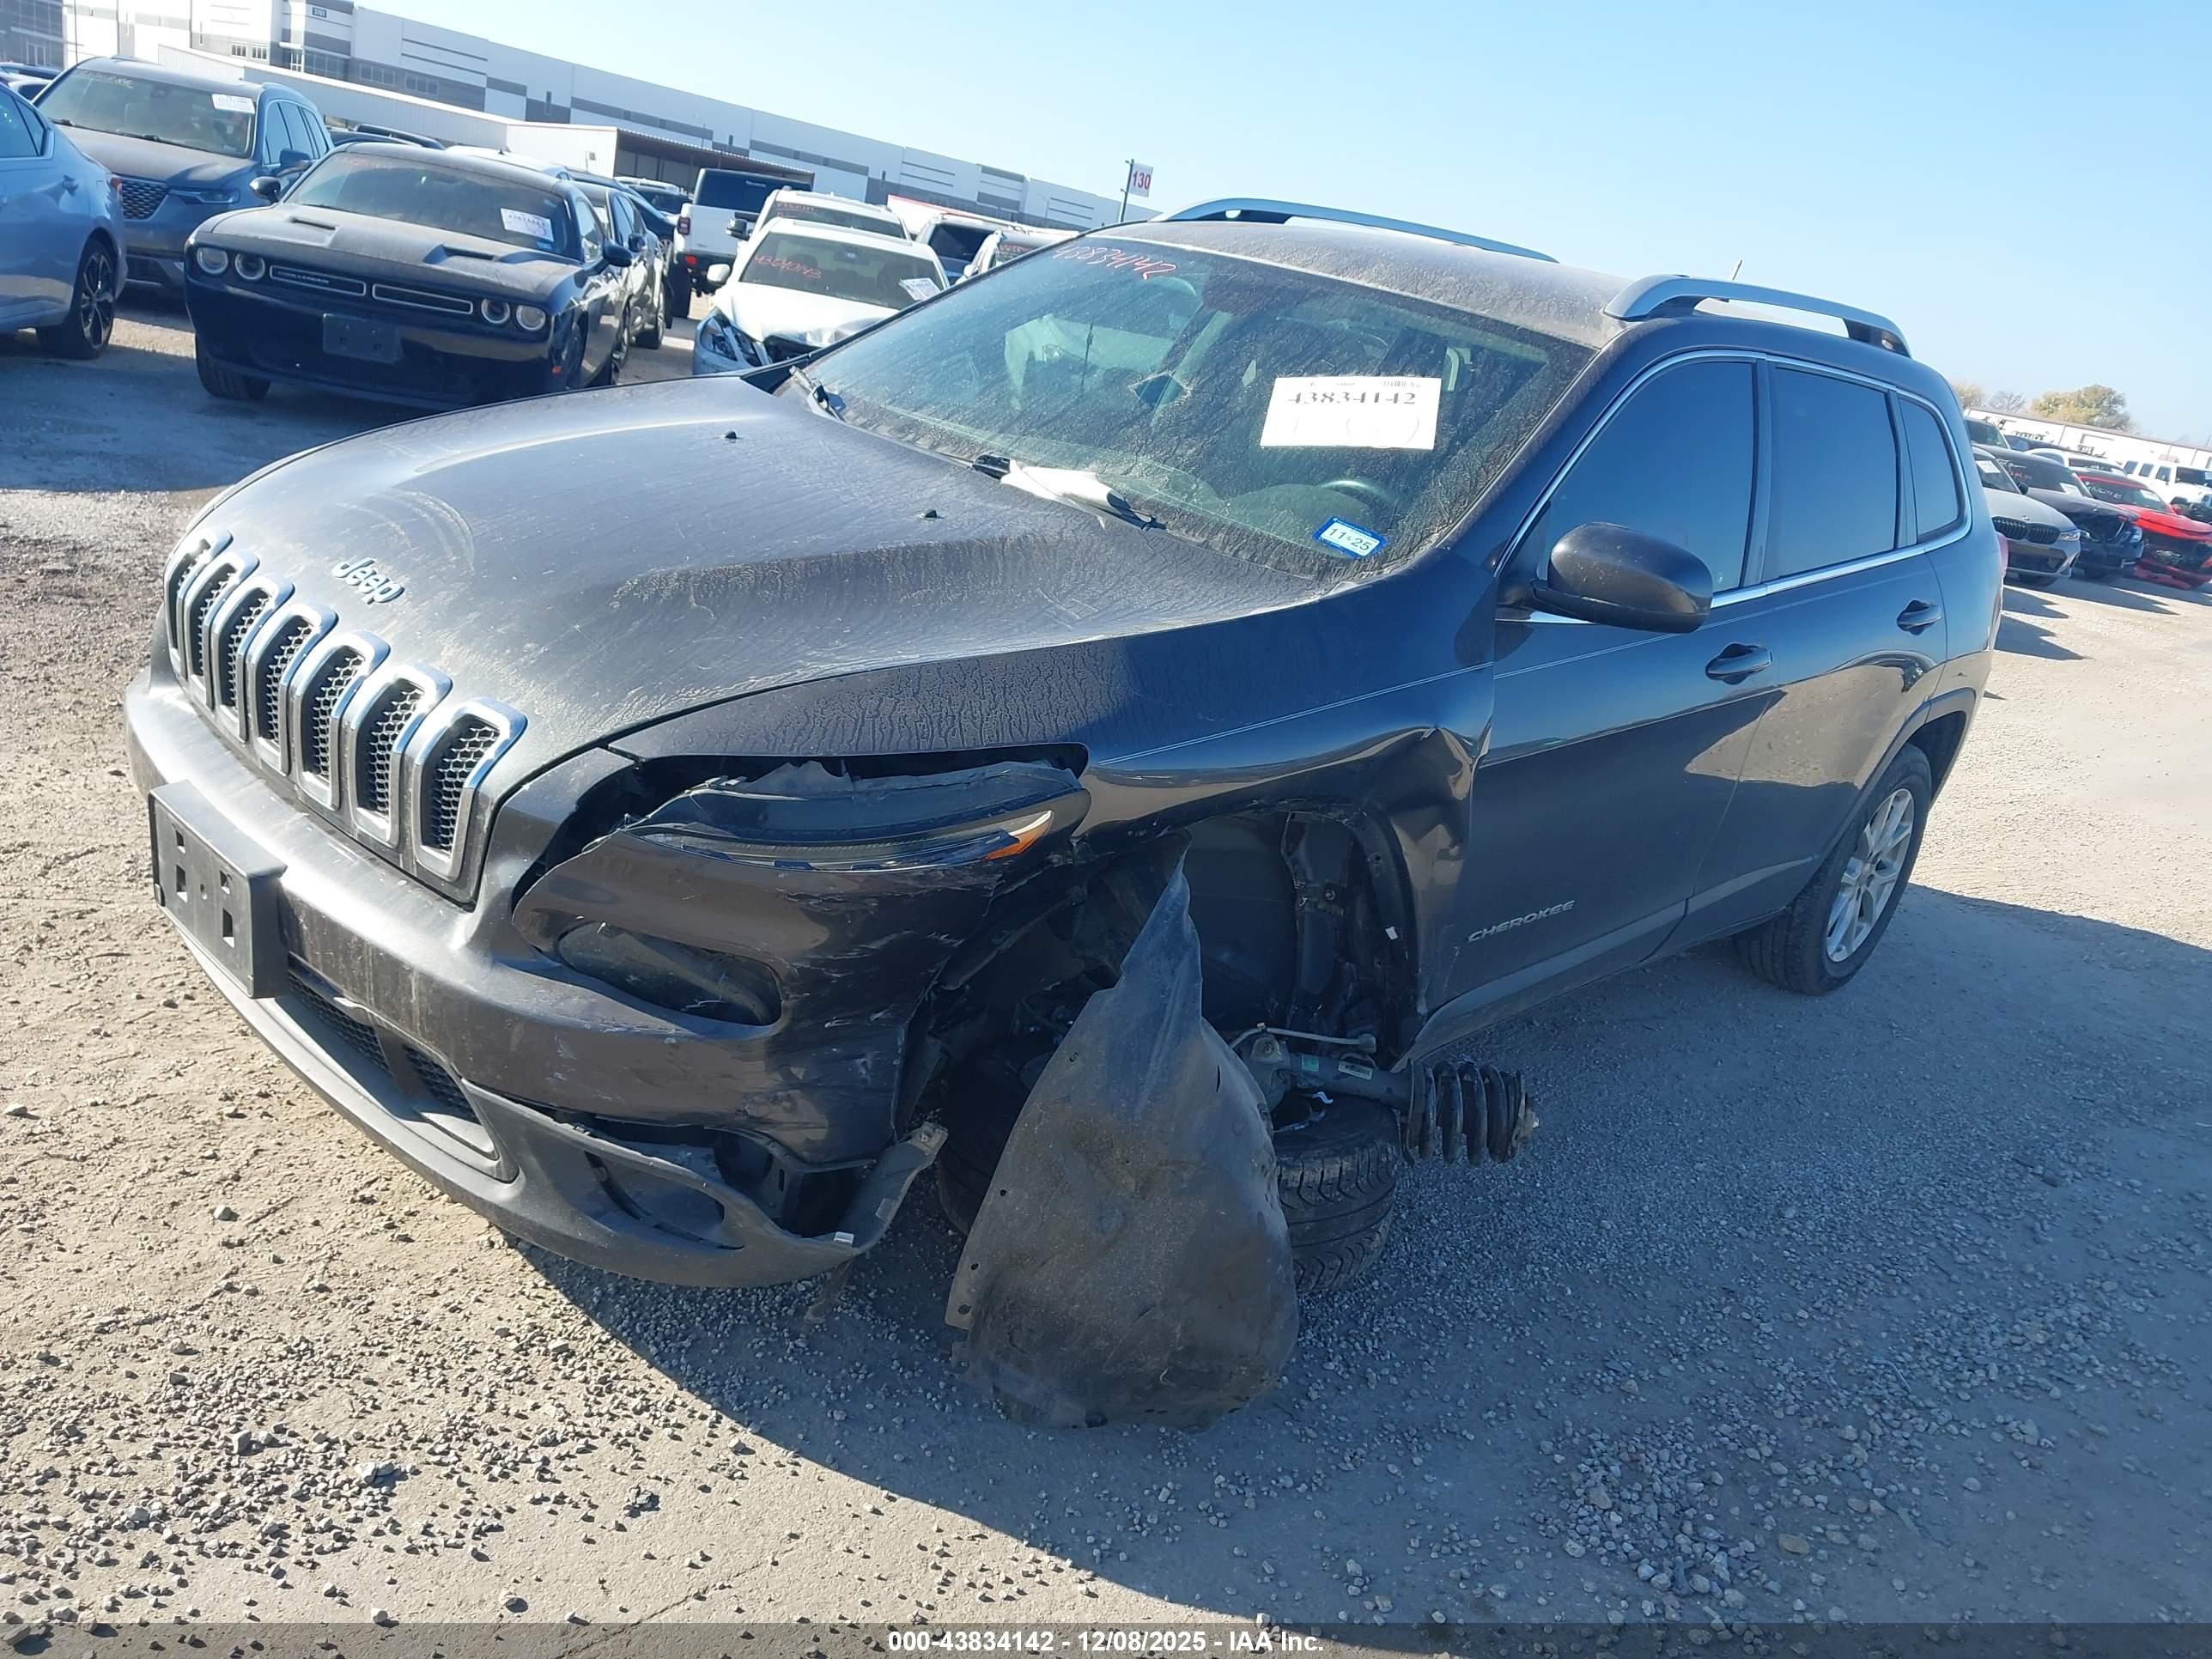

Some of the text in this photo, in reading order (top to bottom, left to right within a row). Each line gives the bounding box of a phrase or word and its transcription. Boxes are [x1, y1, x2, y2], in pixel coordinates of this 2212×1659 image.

[1133, 171, 1152, 190] 130
[1287, 391, 1417, 405] 43834142
[331, 556, 406, 605] Jeep
[1468, 900, 1577, 943] CHEROKEE
